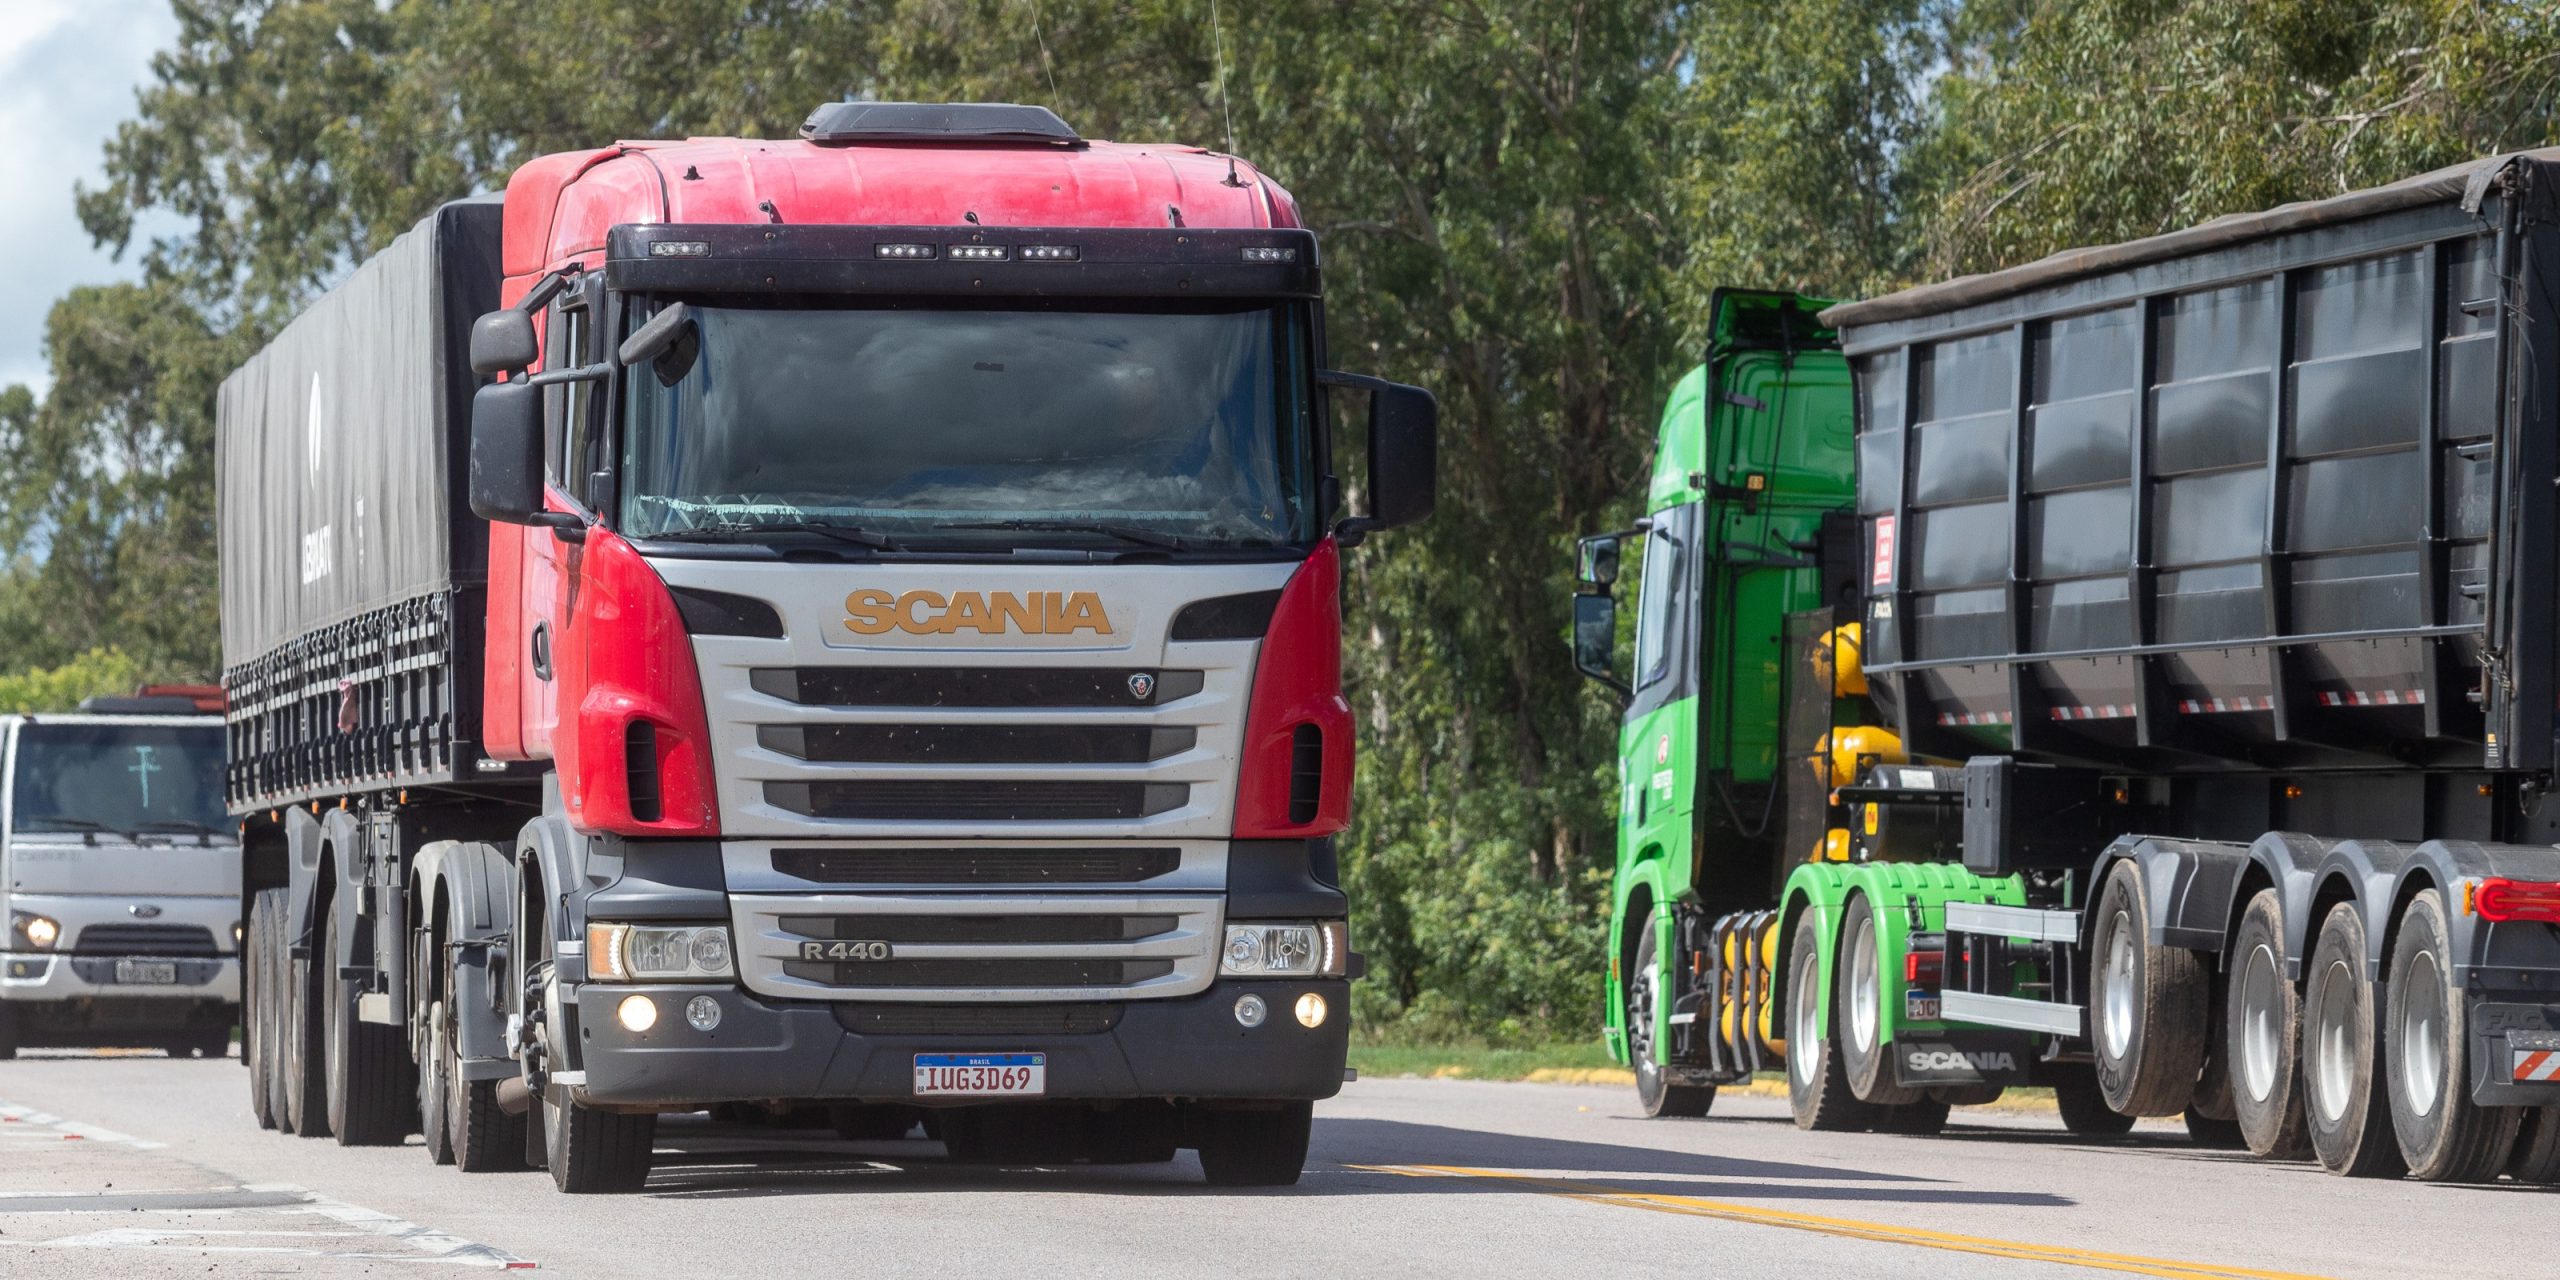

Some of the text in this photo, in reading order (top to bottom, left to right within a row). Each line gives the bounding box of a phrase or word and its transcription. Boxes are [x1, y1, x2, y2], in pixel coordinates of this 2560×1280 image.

[843, 588, 1114, 635] SCANIA
[804, 942, 888, 960] R 440
[1909, 1051, 2017, 1072] SCANIA
[926, 1067, 1031, 1091] IUG3D69
